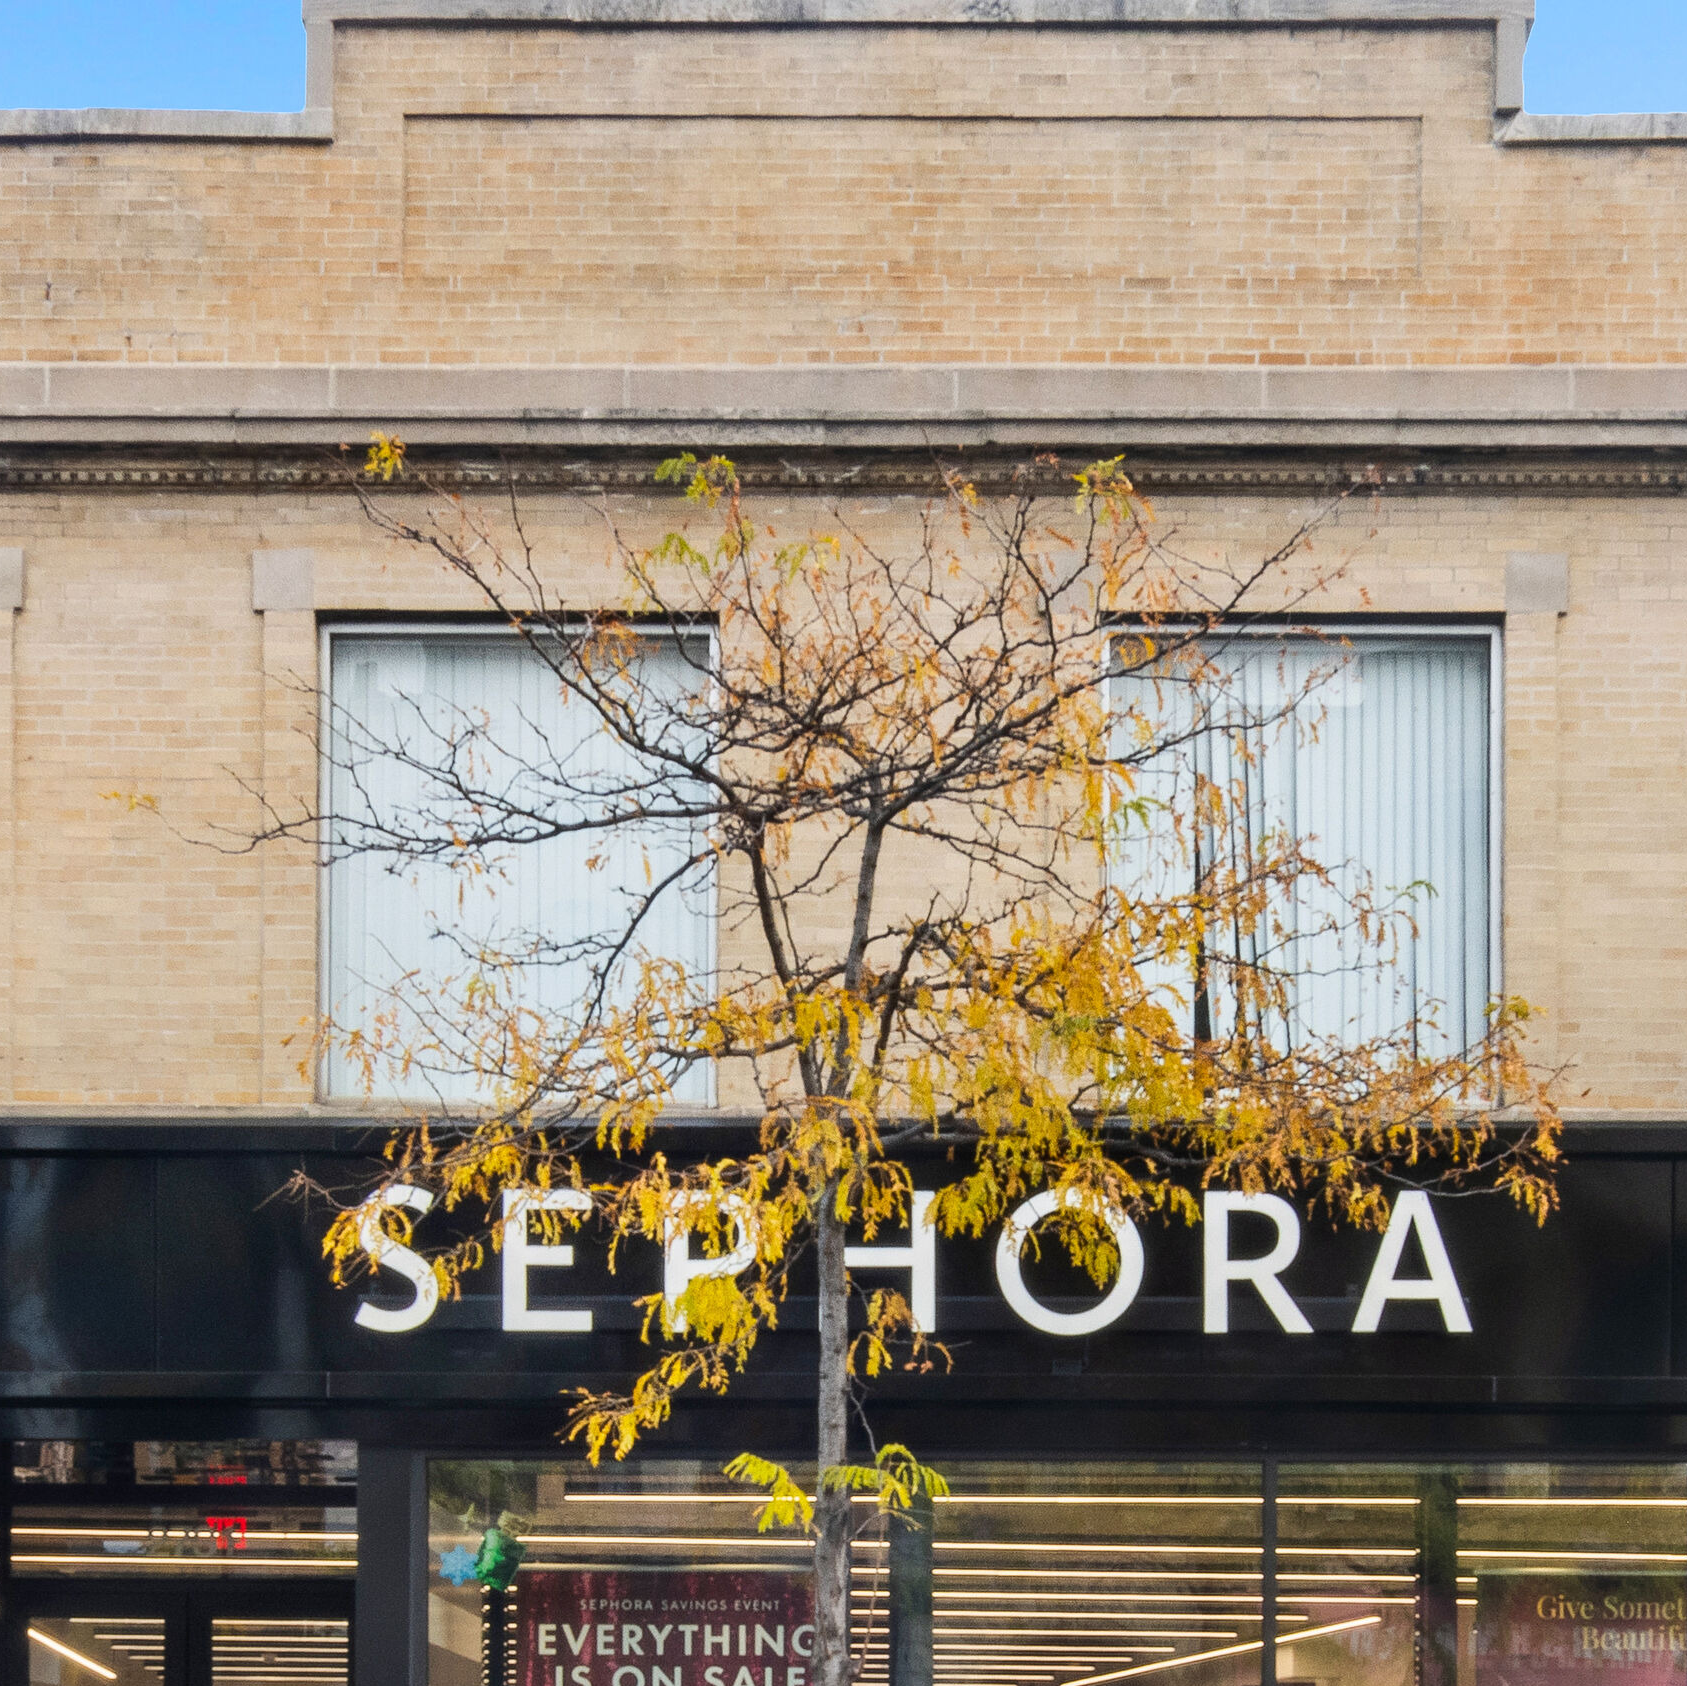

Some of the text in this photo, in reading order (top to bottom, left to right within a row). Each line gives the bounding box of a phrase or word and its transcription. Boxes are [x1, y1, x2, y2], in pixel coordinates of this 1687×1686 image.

[355, 1184, 1474, 1336] SEPHORA
[579, 1599, 781, 1612] SEPHORA SAVINGS EVENT
[1536, 1594, 1594, 1619] Give
[537, 1624, 815, 1657] EVERYTHING
